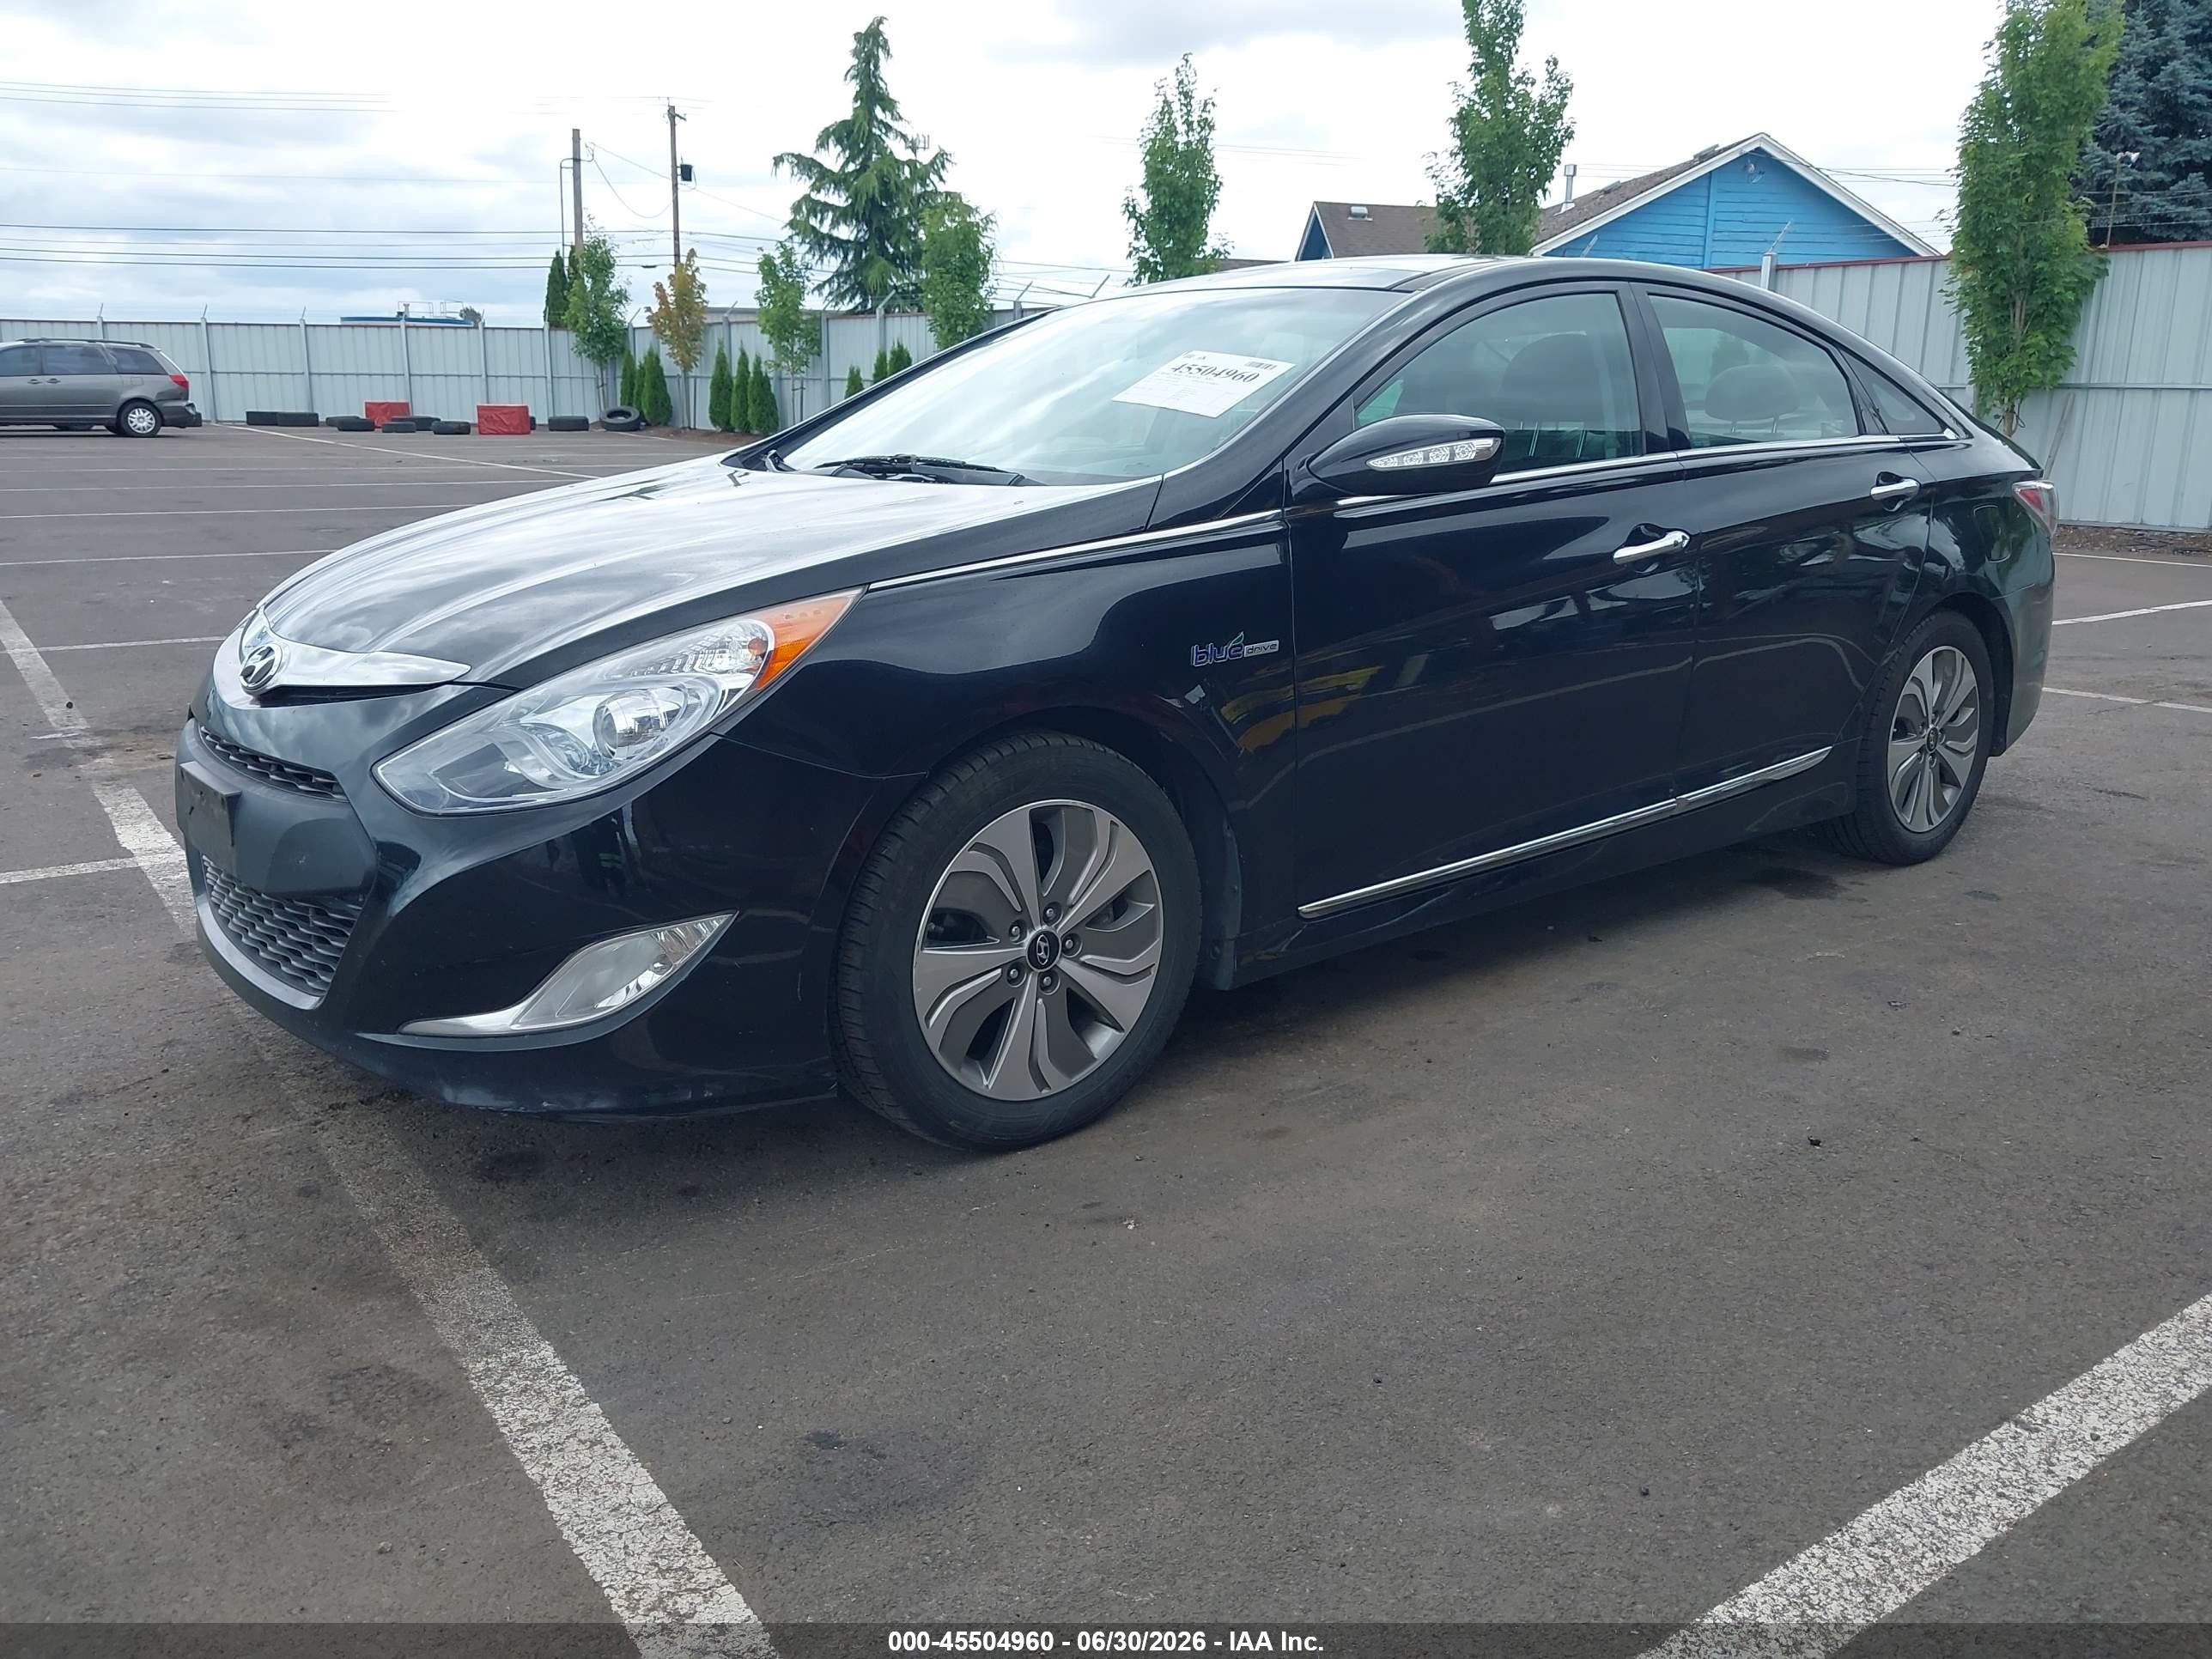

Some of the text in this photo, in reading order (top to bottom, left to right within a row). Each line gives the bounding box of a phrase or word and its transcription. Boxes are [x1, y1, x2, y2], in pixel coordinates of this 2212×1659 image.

[1170, 362, 1260, 384] 45504960
[1191, 641, 1278, 666] blue drive
